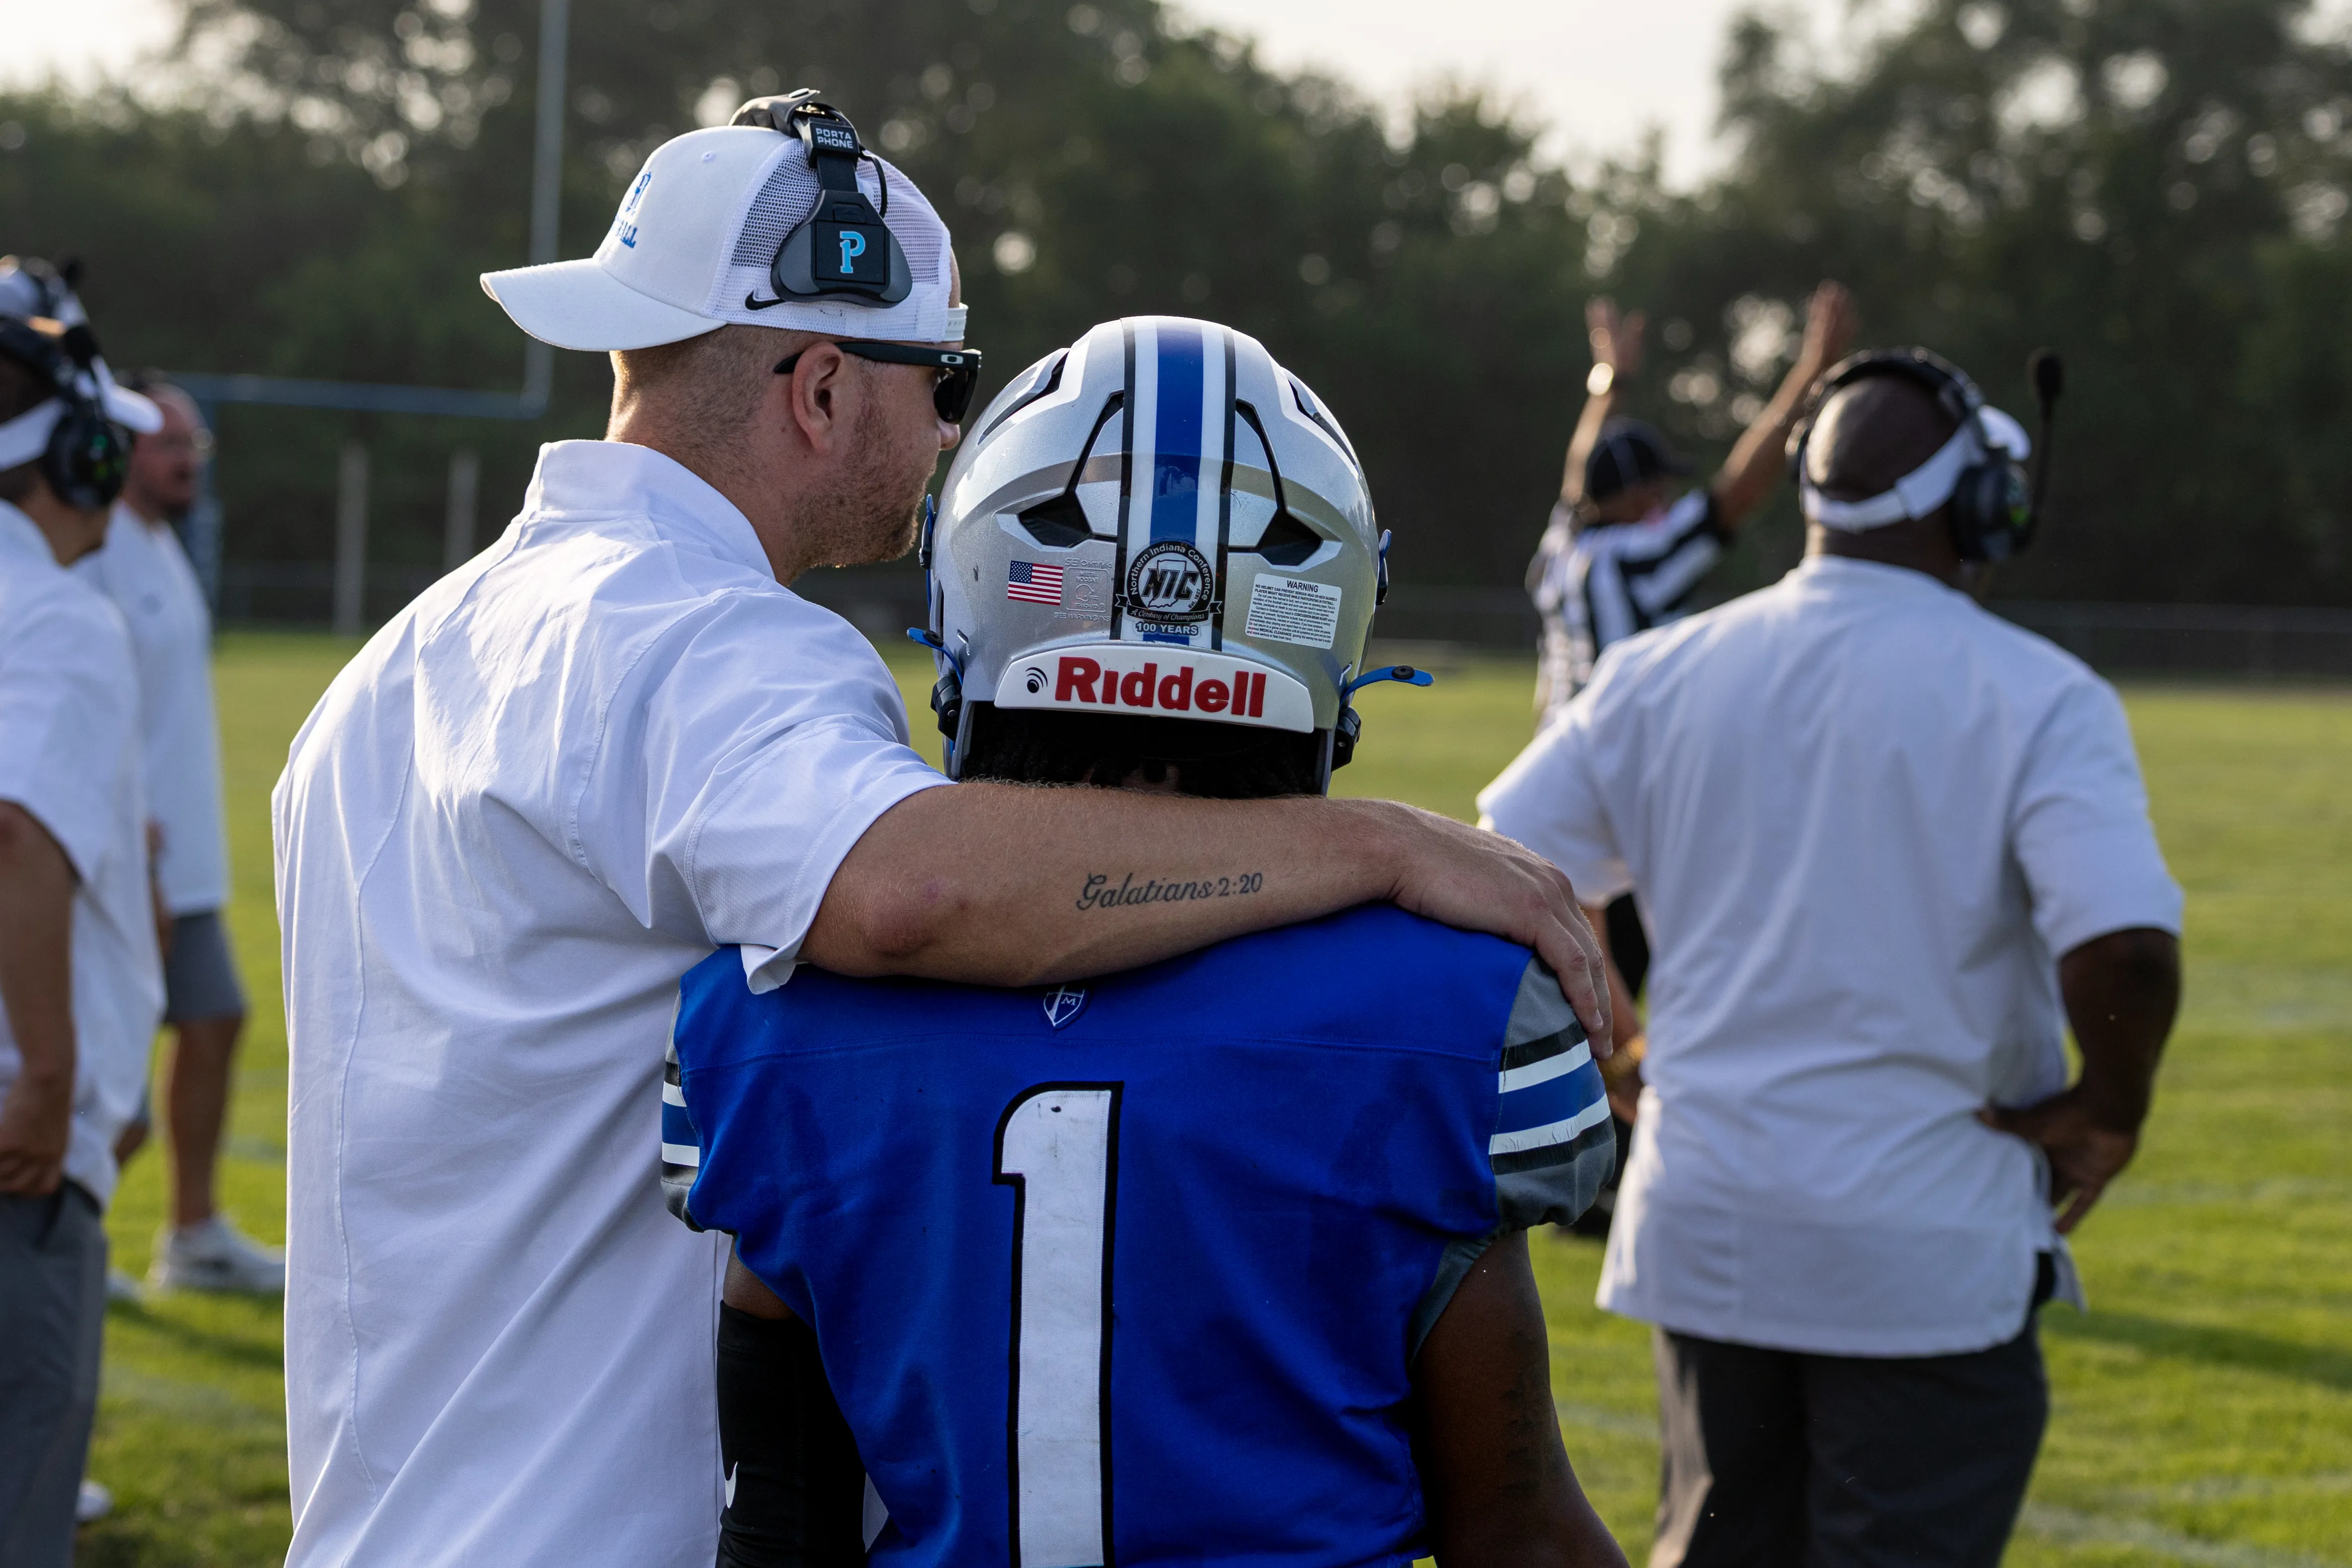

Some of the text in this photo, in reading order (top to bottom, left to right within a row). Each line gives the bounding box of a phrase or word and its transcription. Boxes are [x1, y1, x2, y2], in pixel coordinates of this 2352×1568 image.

[816, 128, 852, 140] PORTA
[817, 136, 853, 149] PHONE
[840, 231, 865, 273] P
[1081, 559, 1113, 568] Certified
[1130, 543, 1211, 600] Northern Indiana Conference
[1141, 568, 1199, 600] NIC
[1286, 580, 1319, 593] WARNING
[1138, 611, 1162, 620] Century
[1136, 623, 1197, 635] 100 YEARS
[1054, 656, 1266, 717] Riddell
[1076, 872, 1264, 910] Galatians 2:20
[992, 1081, 1123, 1567] 1
